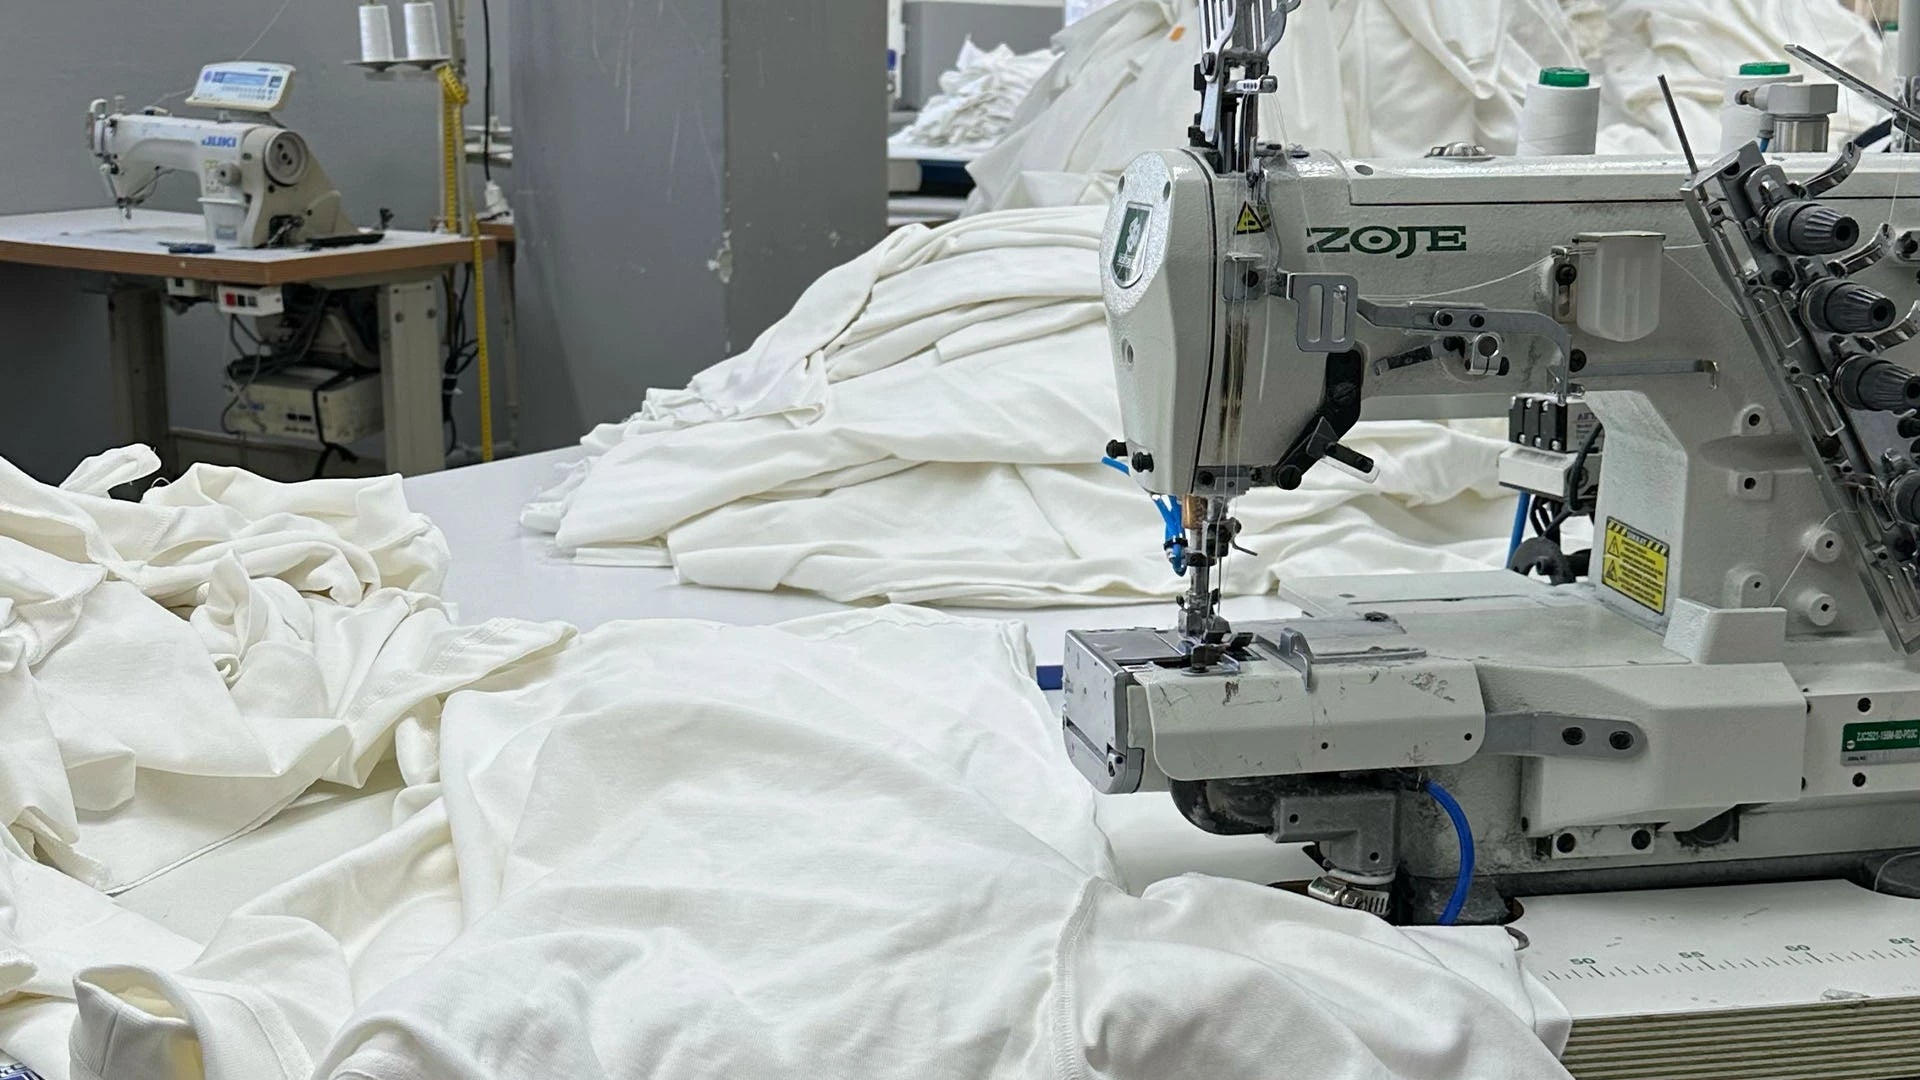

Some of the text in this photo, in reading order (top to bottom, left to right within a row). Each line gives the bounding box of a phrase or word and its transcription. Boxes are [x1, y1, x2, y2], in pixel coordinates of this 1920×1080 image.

[202, 135, 237, 148] JUKI
[1306, 225, 1467, 259] ZOJE
[1569, 937, 1915, 965] 50 55 60 65
